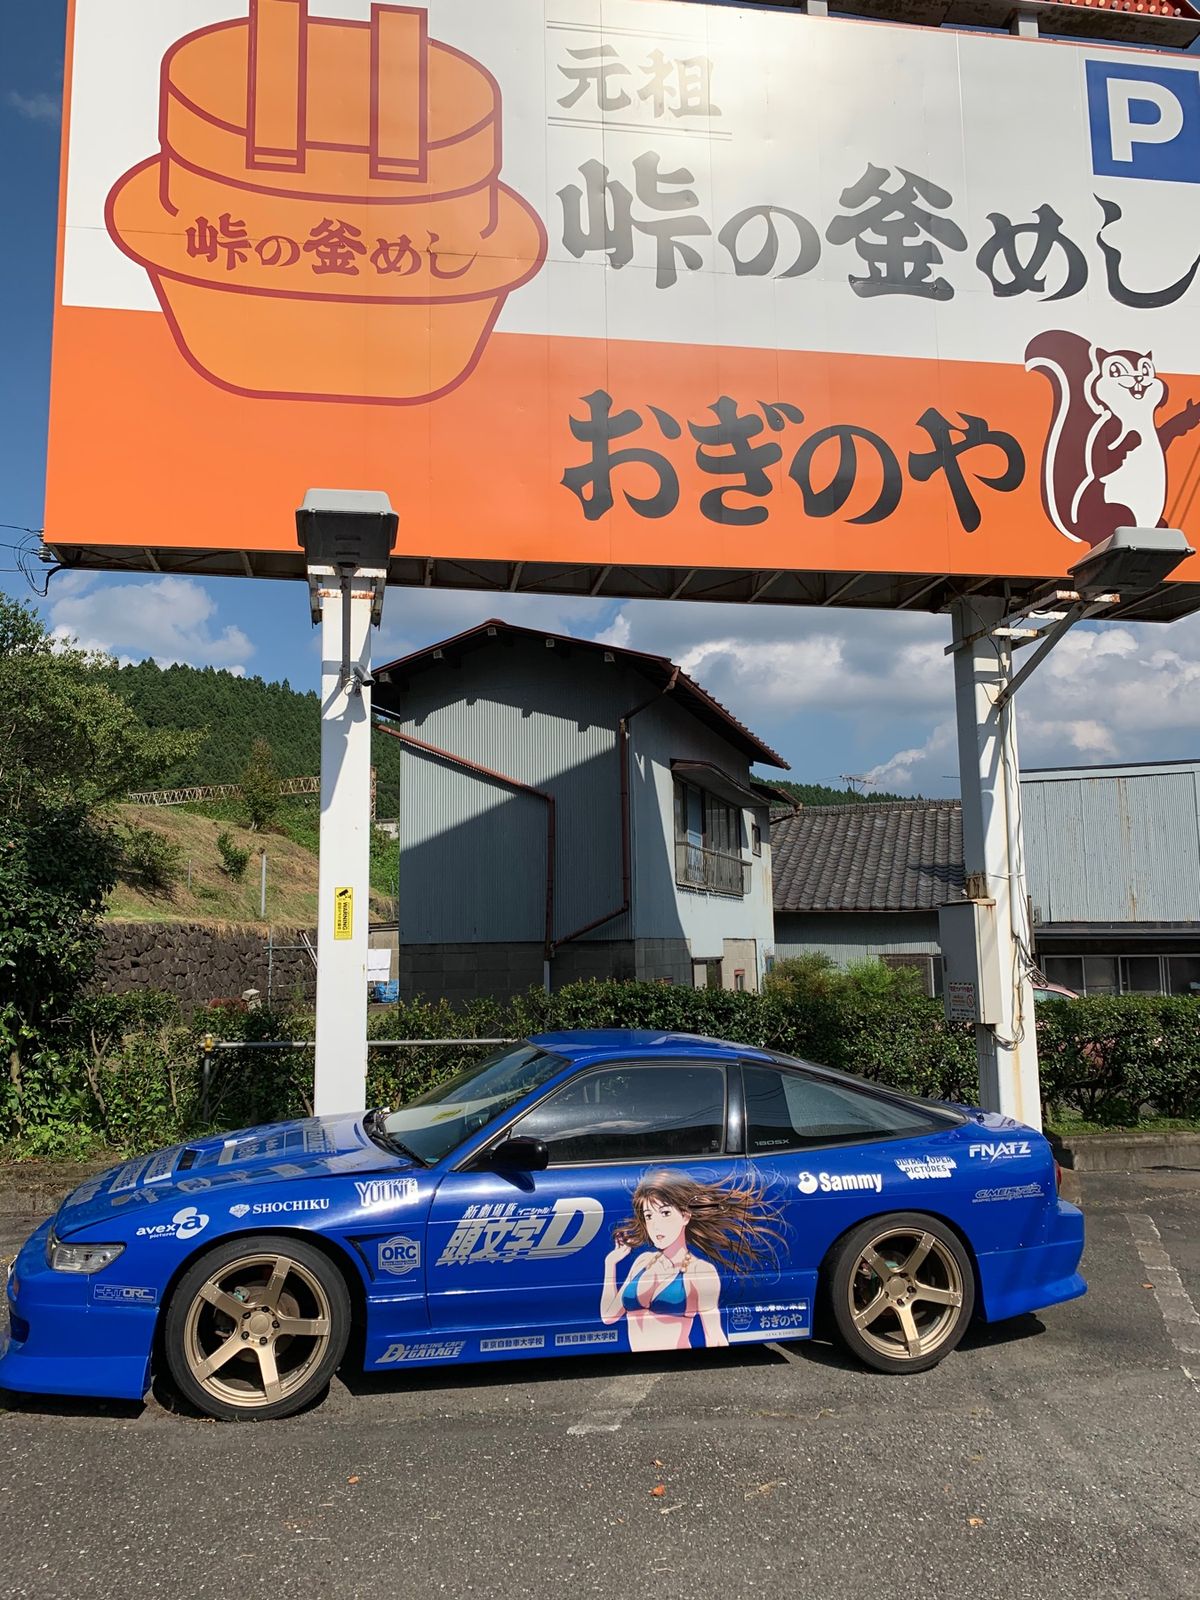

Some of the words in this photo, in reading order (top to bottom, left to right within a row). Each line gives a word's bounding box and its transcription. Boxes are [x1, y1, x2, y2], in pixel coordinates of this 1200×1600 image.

[555, 43, 724, 121] 元祖
[1106, 77, 1185, 163] P
[555, 150, 1200, 309] 峠の釜めし
[185, 212, 479, 280] 峠の釜めし
[560, 388, 1027, 533] おぎのや
[969, 1141, 1032, 1163] FNATZ
[819, 1172, 882, 1193] Sammy
[252, 1199, 330, 1214] SHOCHIKU
[135, 1224, 176, 1236] avex
[149, 1231, 175, 1239] pictures
[382, 1245, 417, 1261] ORC
[760, 1313, 803, 1328] おぎのや
[408, 1346, 463, 1359] GARAGE
